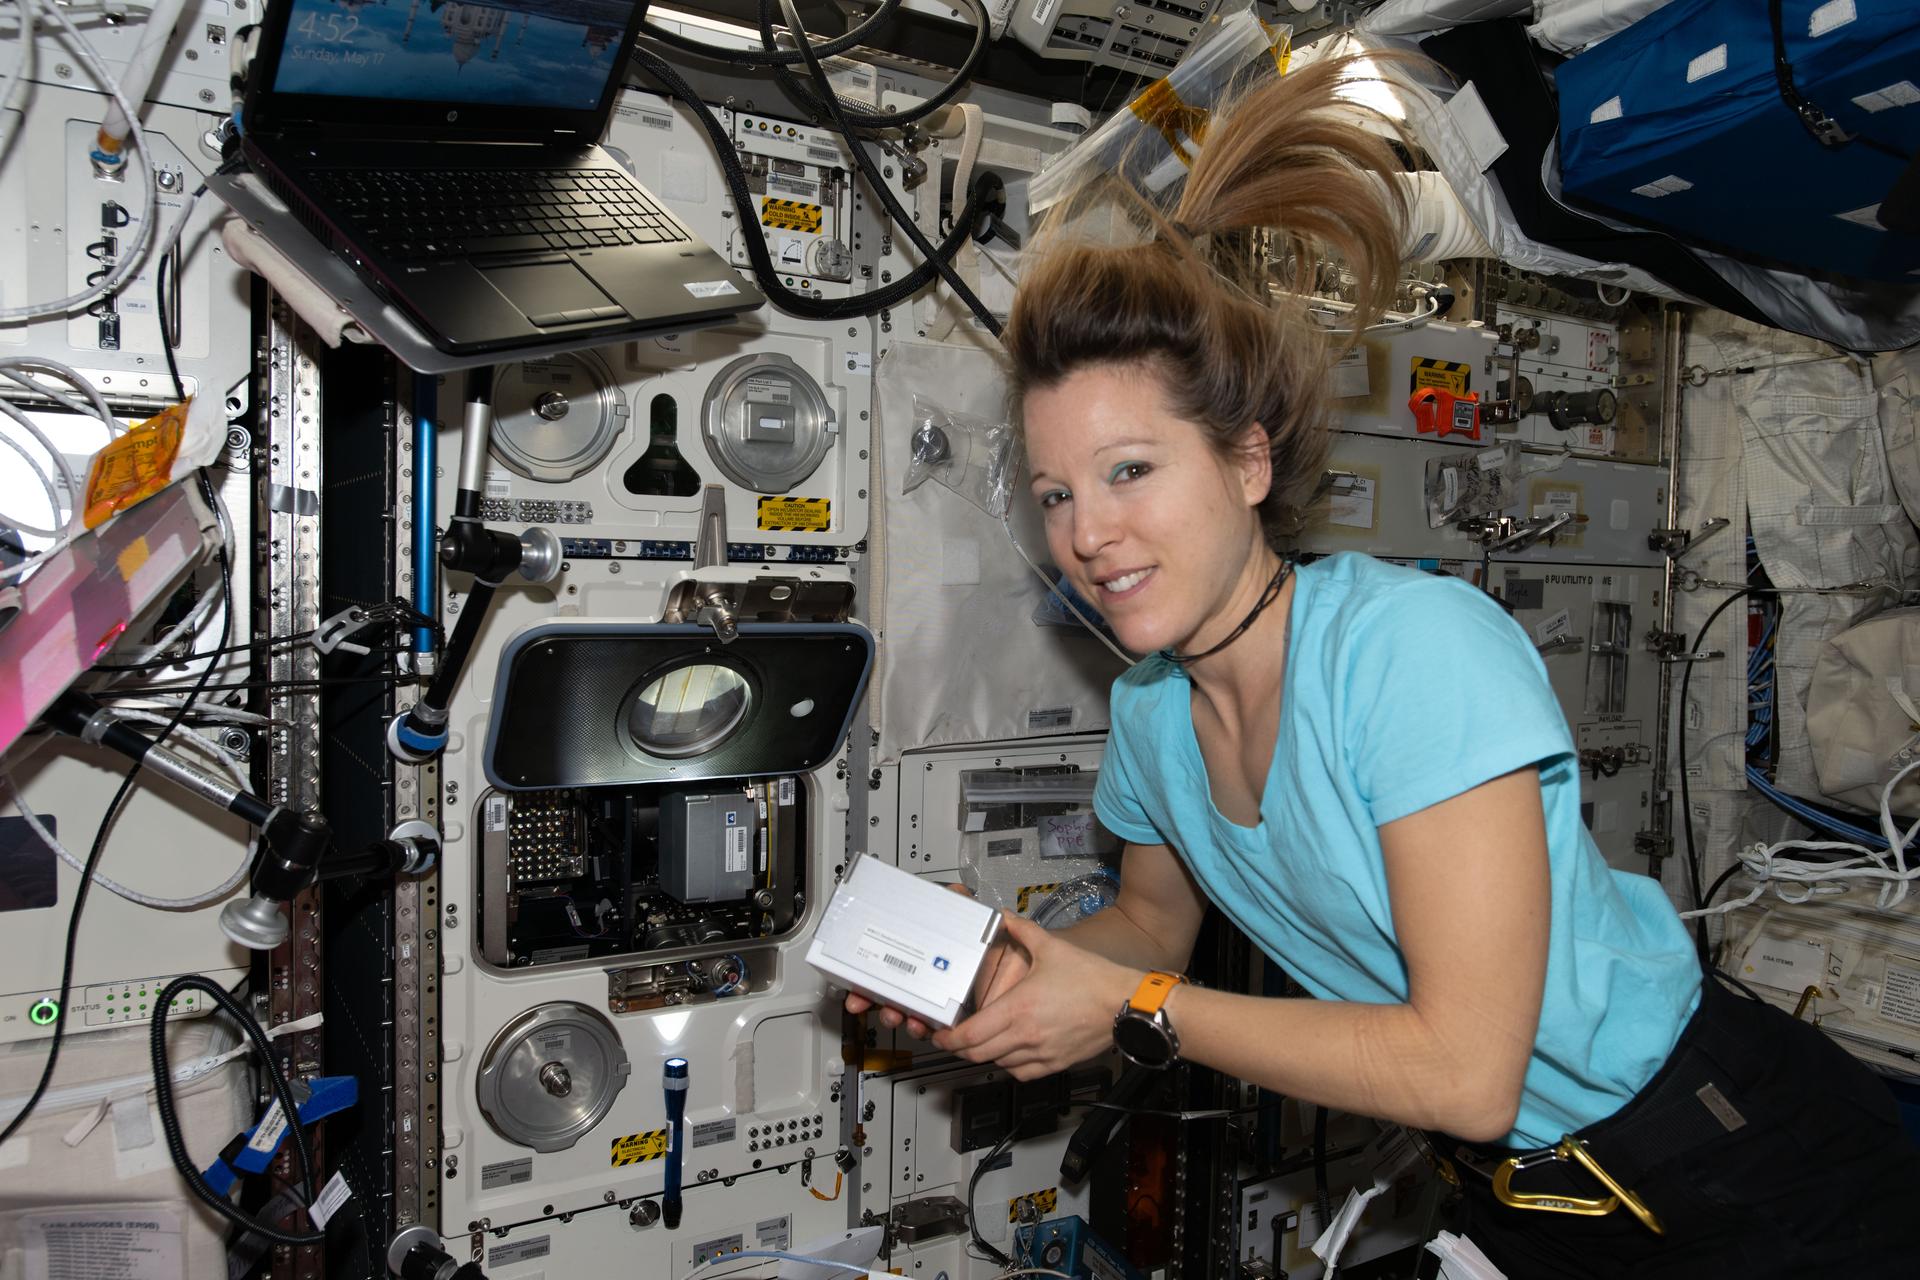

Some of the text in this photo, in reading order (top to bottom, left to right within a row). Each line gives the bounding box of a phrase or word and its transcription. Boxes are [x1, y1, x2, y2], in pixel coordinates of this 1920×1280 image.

[298, 11, 358, 44] 4:52
[292, 45, 385, 68] Sunday, May 17
[768, 204, 796, 213] WARNING
[1551, 575, 1560, 584] PU
[1562, 575, 1587, 584] UTILITY
[1048, 818, 1094, 834] Sophie
[1056, 836, 1084, 848] PPE
[72, 1004, 100, 1012] STATUS
[621, 1139, 648, 1148] WARNING
